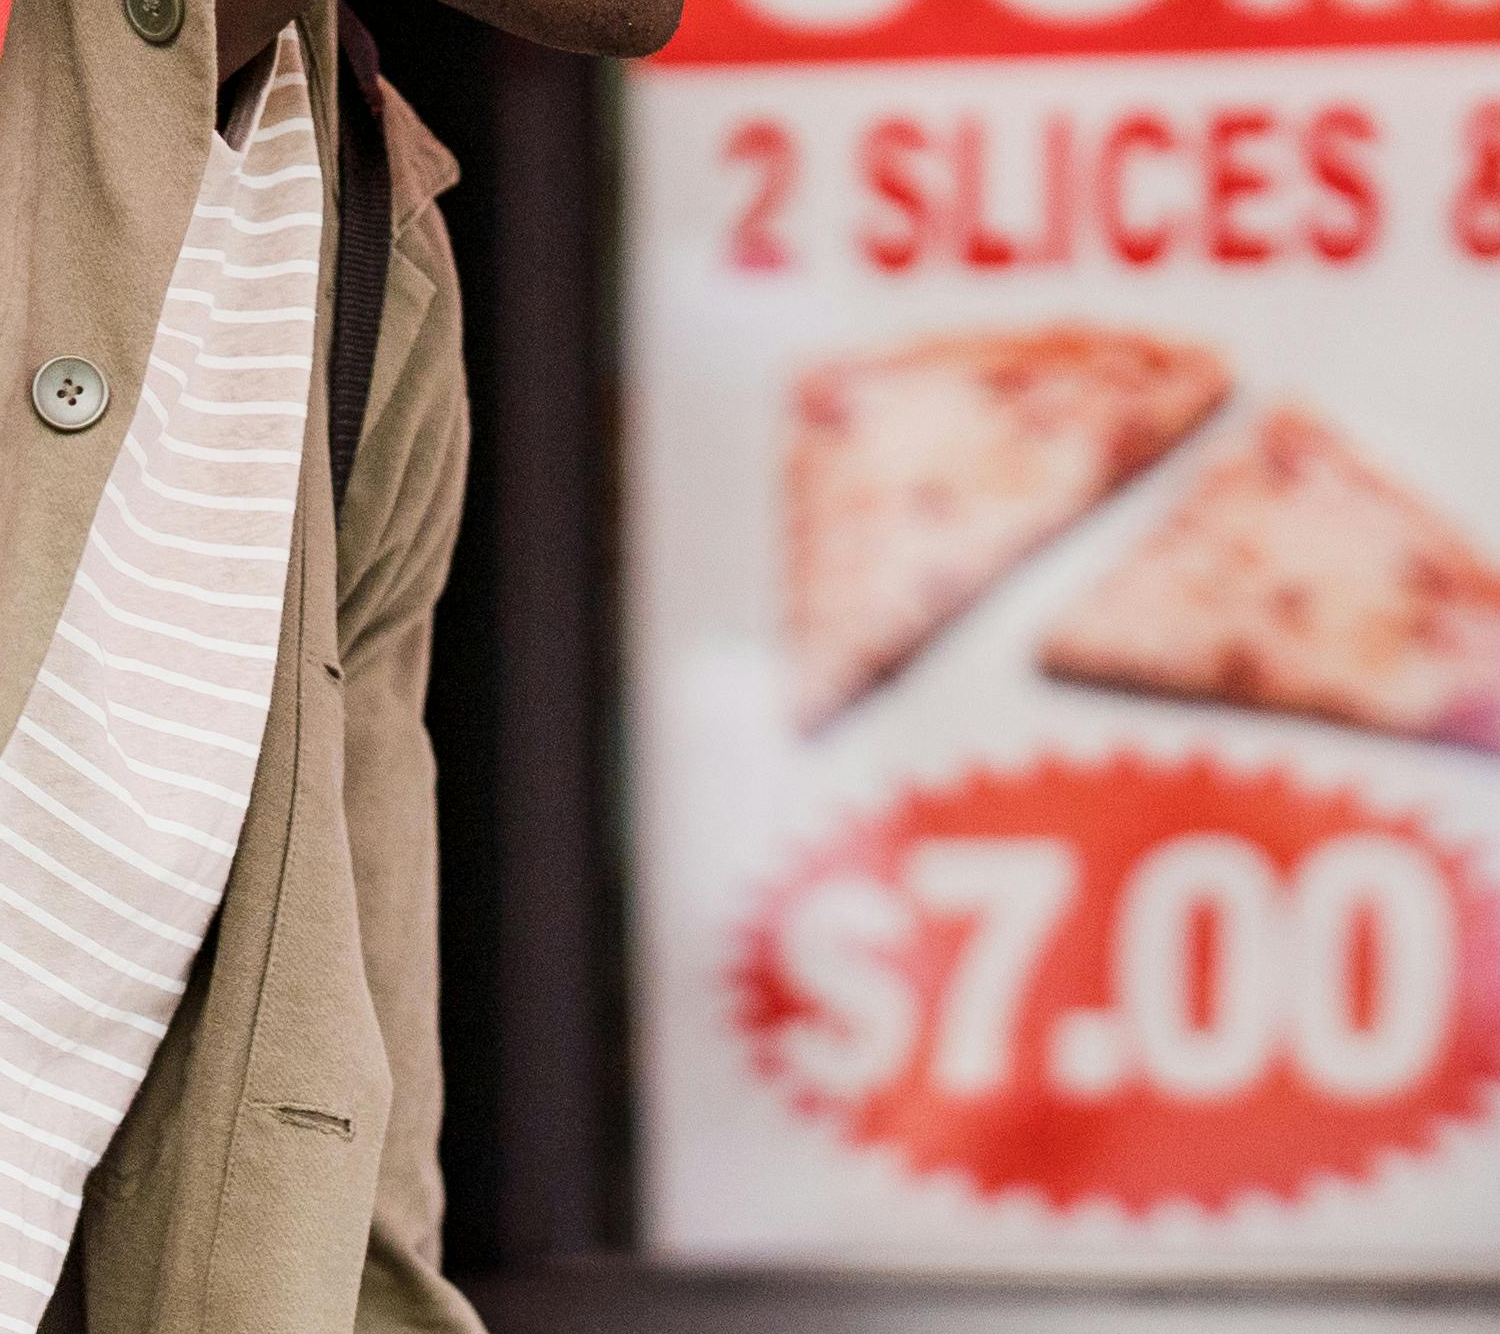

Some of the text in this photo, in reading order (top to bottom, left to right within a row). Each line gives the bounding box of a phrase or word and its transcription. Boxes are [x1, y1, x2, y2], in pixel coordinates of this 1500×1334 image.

[722, 116, 794, 277] 2
[856, 105, 1383, 271] SLICES
[783, 829, 1460, 1103] $7.00
